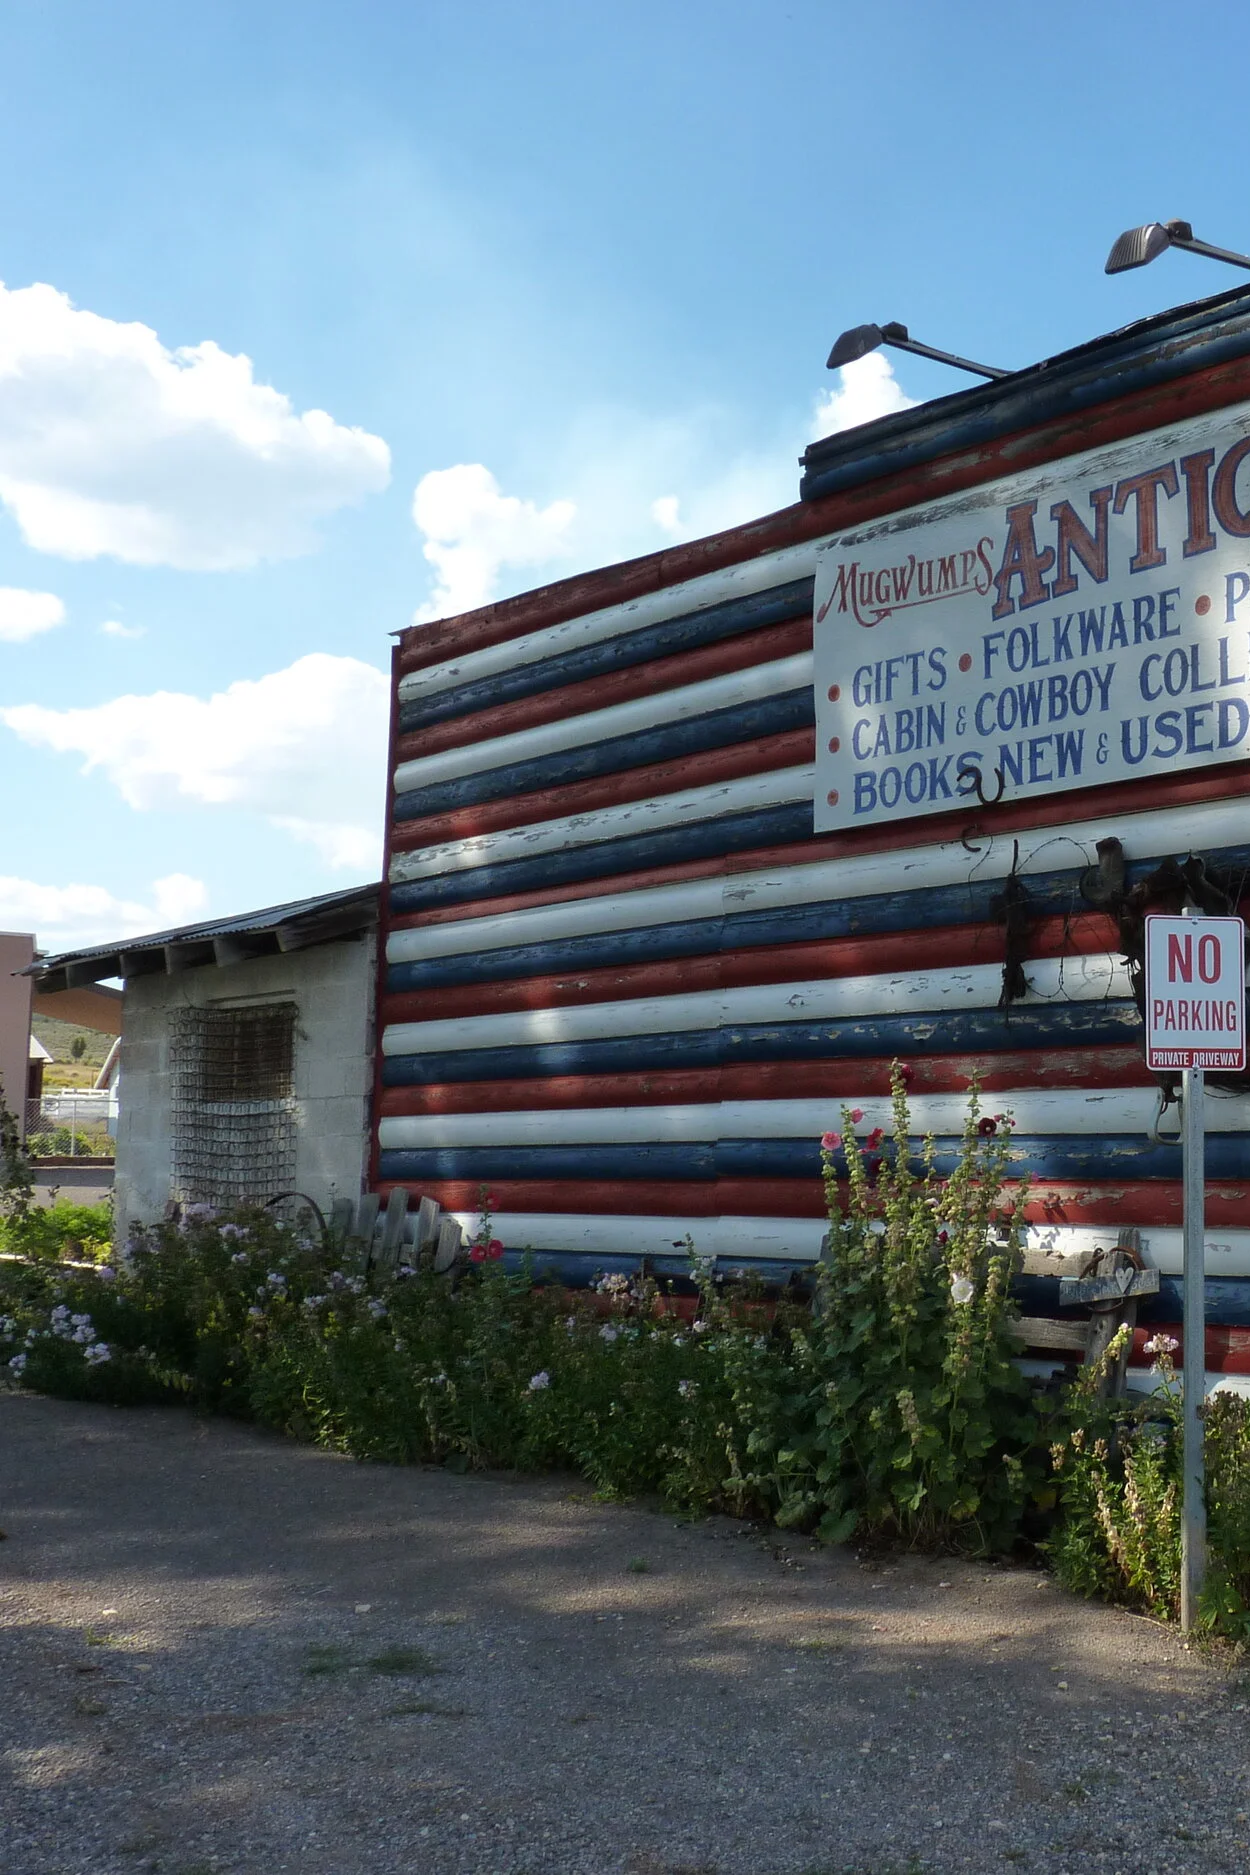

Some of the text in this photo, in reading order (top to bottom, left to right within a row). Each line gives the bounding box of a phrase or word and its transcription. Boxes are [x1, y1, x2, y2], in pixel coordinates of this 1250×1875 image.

[852, 646, 948, 708] GIFTS
[982, 586, 1181, 679] FOLKWARE
[851, 701, 946, 761] CABIN
[974, 662, 1116, 737] COWBOY
[851, 750, 985, 815] BOOKS
[997, 728, 1086, 789] NEW
[1120, 697, 1250, 766] USED
[1168, 933, 1222, 984] NO
[1153, 999, 1237, 1032] PARKING
[1152, 1051, 1240, 1067] PRIVATE DRIVEWAY
